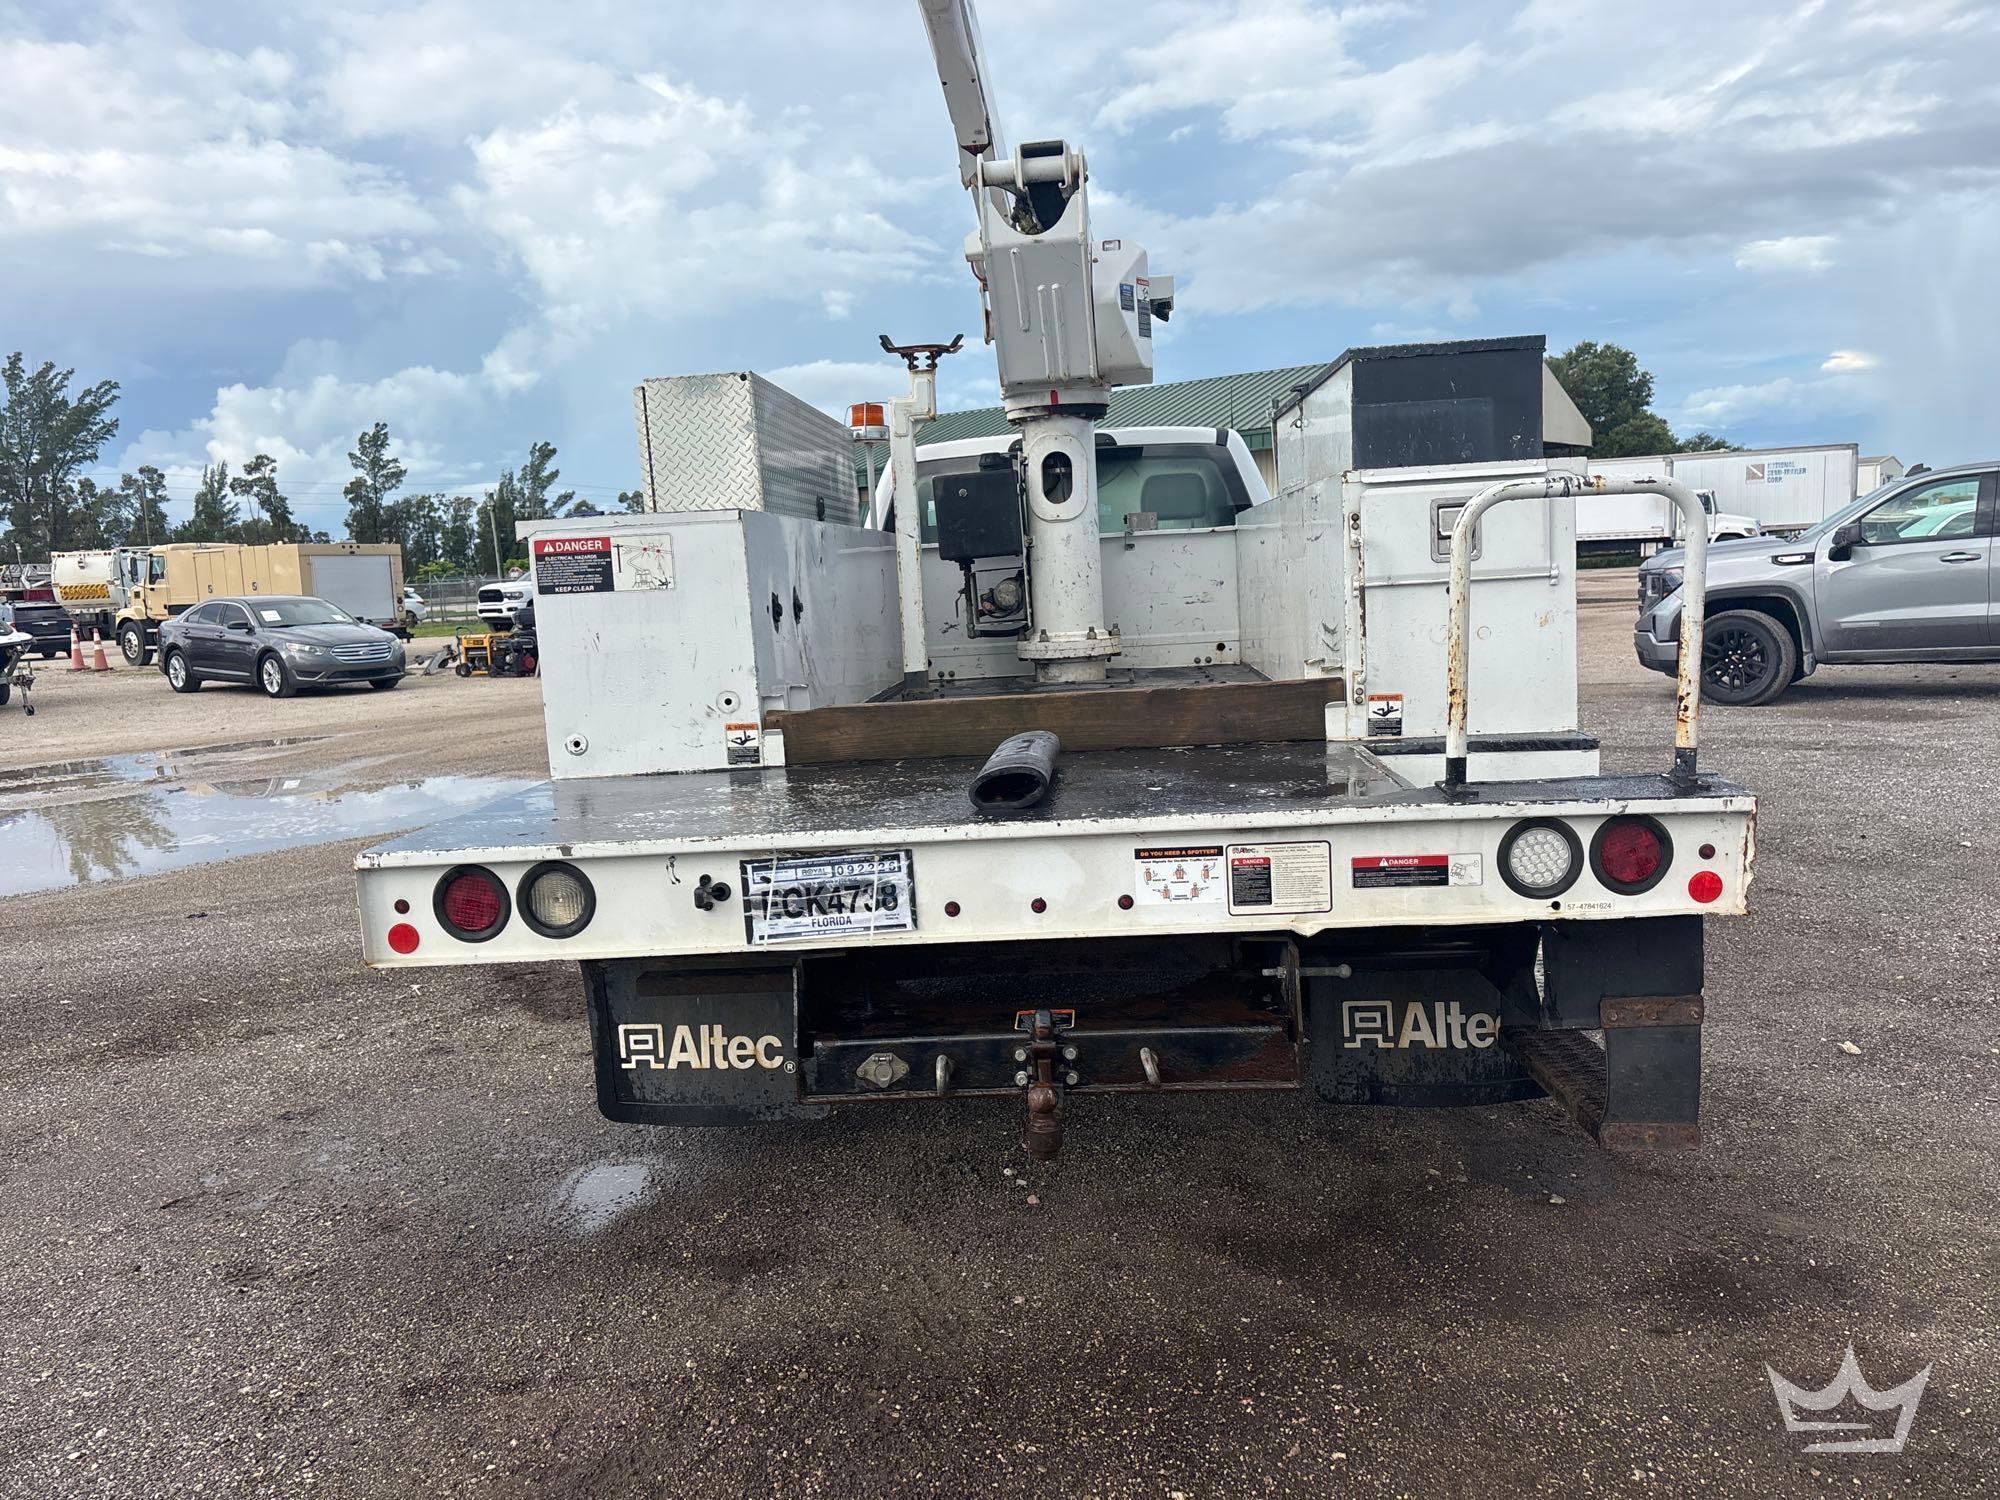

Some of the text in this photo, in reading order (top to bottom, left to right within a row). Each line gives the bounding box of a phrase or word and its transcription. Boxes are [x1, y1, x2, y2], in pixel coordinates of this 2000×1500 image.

[555, 540, 603, 552] DANGER
[801, 867, 826, 876] ROYAL
[1567, 902, 1612, 911] 57-47841624
[811, 915, 852, 928] FLORIDA
[1398, 1001, 1501, 1050] Alte
[667, 1024, 784, 1070] Altec
